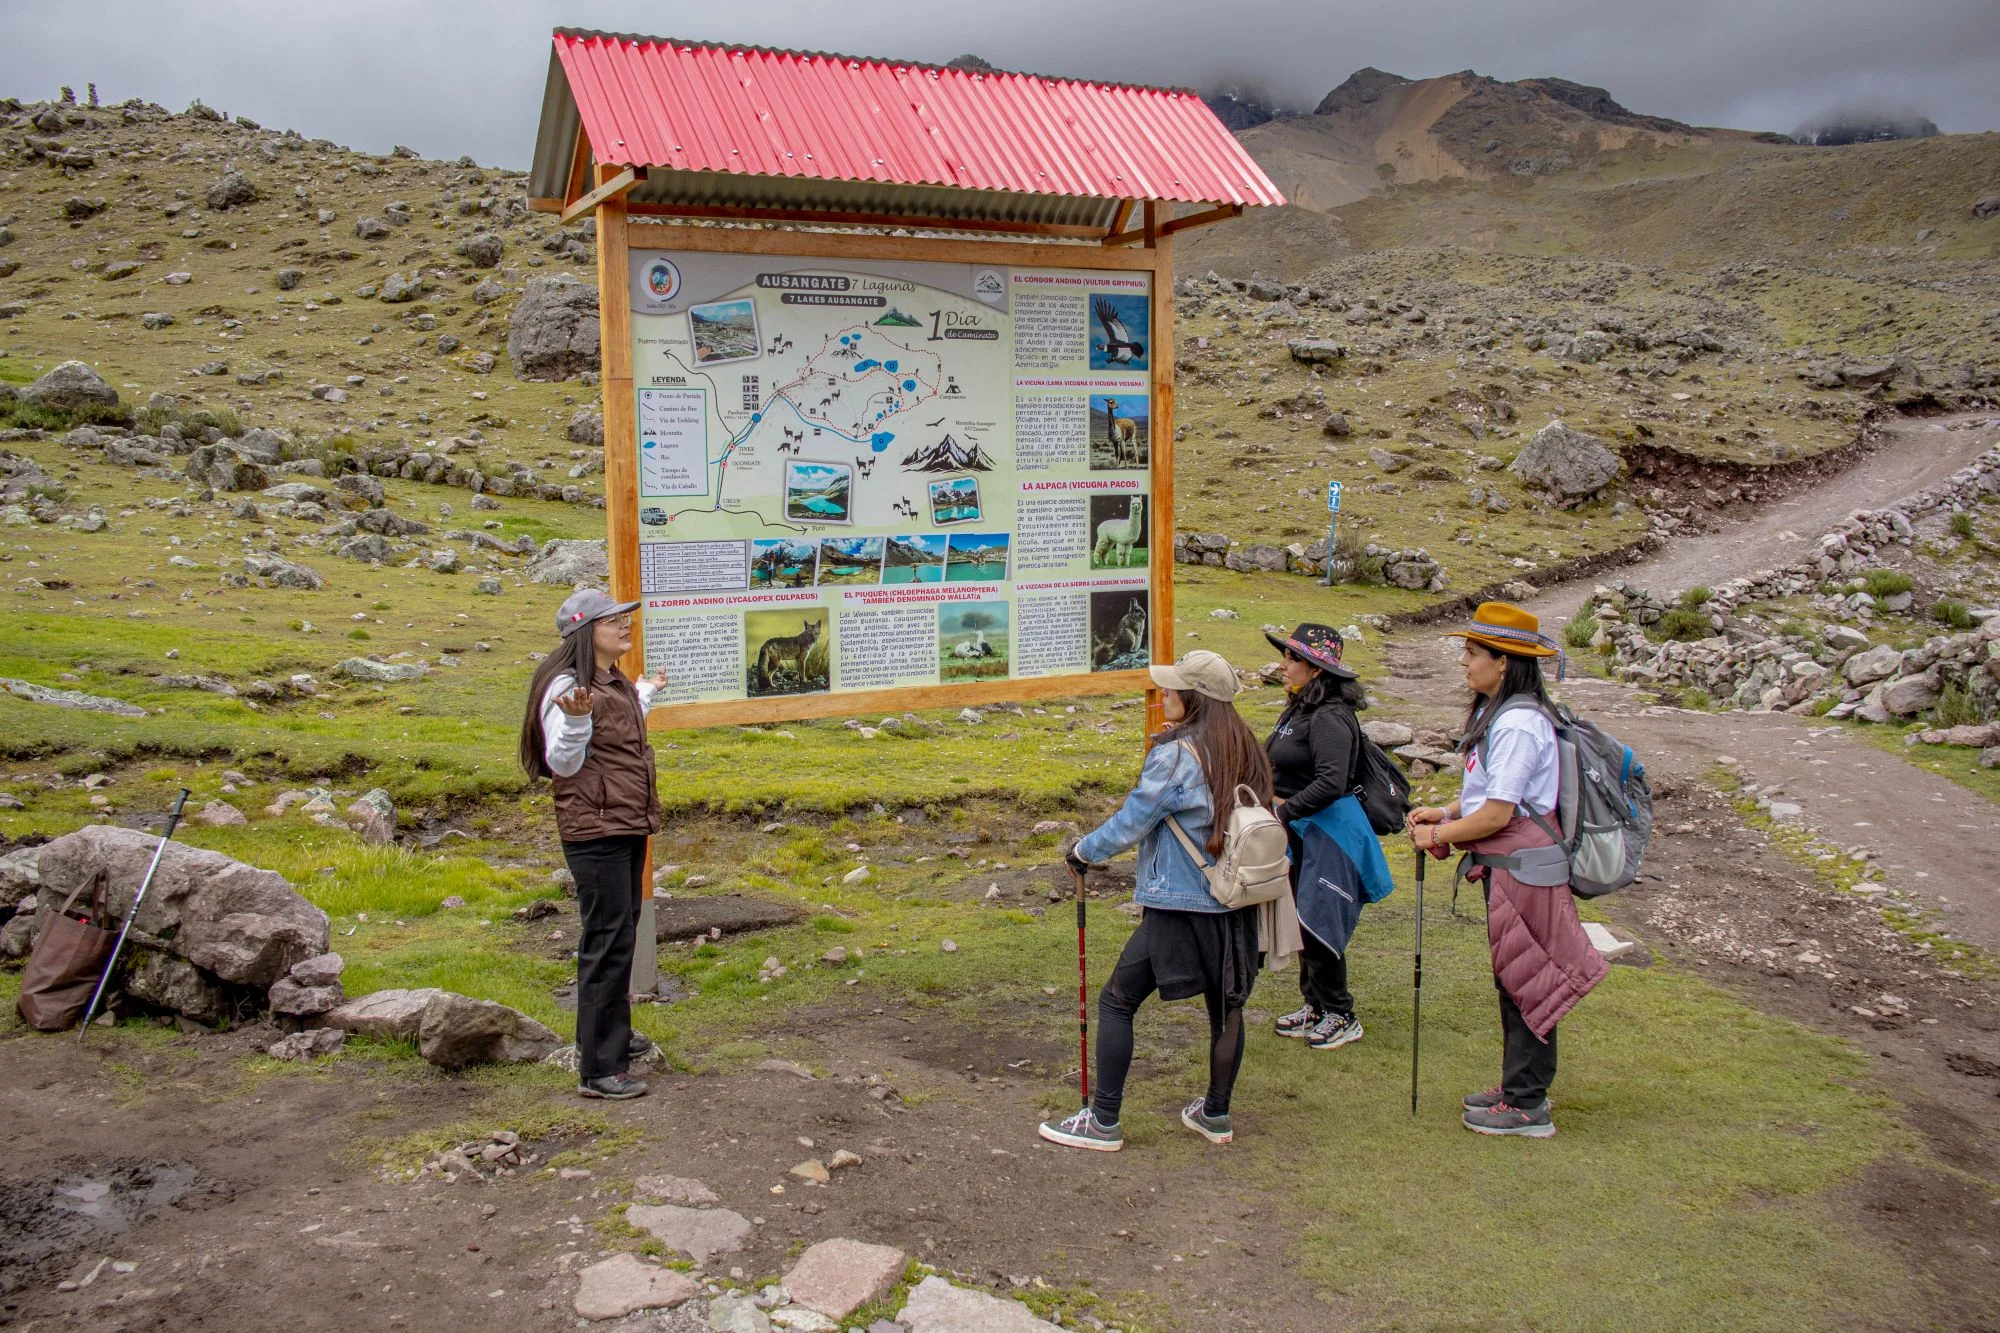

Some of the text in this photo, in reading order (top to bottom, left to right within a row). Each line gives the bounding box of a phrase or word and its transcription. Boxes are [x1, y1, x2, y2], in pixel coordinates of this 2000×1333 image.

[762, 276, 917, 294] AUSANGATE 7 Lagunas
[1112, 280, 1146, 288] GRYPHUS)
[828, 297, 878, 305] AUSANGATE
[927, 310, 943, 341] 1
[957, 331, 996, 339] Caminata
[1022, 480, 1139, 491] LA ALPACA (VICUGNA PACOS)
[890, 587, 940, 596] (CHLOEPHAGA
[661, 599, 690, 607] ZORRO
[692, 597, 724, 605] ANDINO
[726, 595, 774, 604] (LYCALOPEX
[775, 593, 818, 601] CULPAEUS)
[896, 594, 945, 603] DENOMINADO
